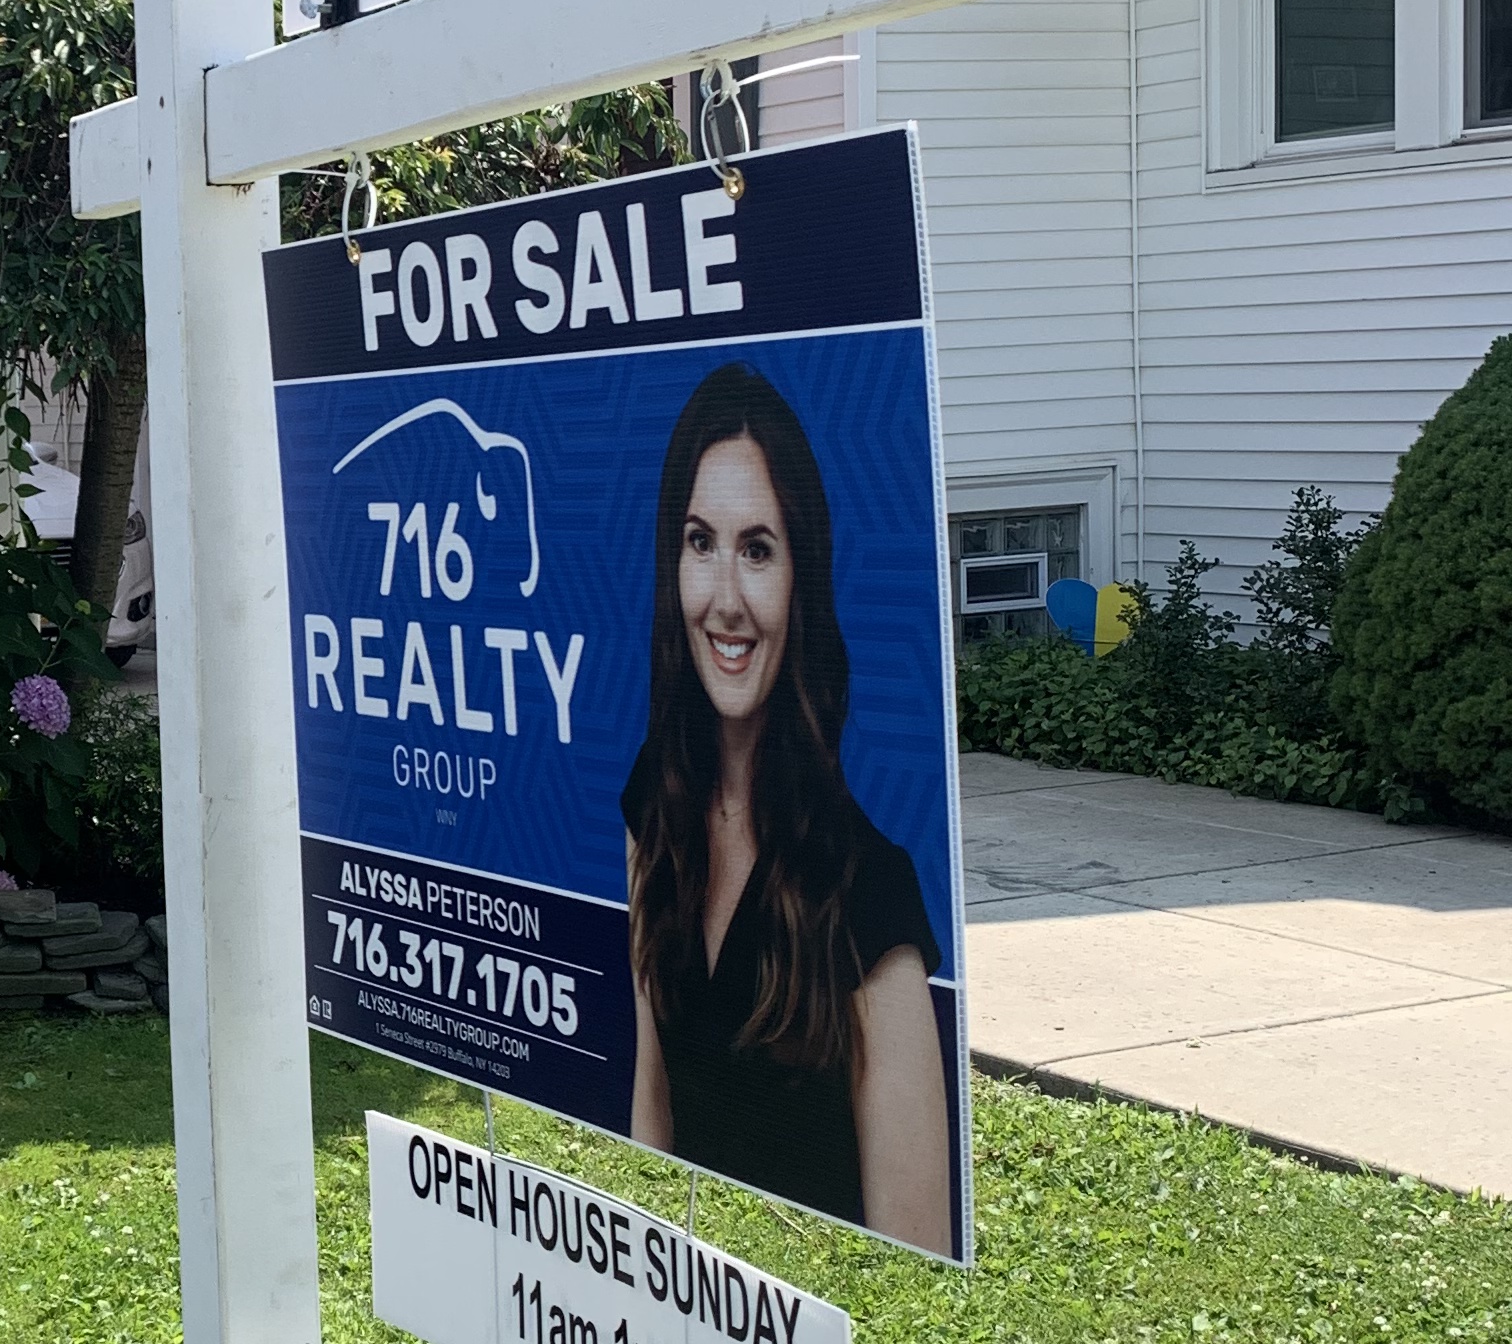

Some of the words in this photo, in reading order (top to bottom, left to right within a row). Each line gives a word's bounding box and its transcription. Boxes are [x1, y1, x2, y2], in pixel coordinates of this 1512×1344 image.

[358, 233, 499, 352] FOR
[510, 188, 744, 334] SALE
[367, 501, 474, 603] 716
[304, 613, 585, 745] REALTY
[392, 744, 498, 802] GROUP
[339, 860, 424, 912] ALYSSA
[426, 880, 541, 942] PETERSON
[326, 910, 579, 1037] 716.317.1705
[357, 989, 530, 1062] ALYSSA.716REALTYGROUP.COM
[408, 1135, 498, 1229] OPEN
[508, 1168, 635, 1289] HOUSE
